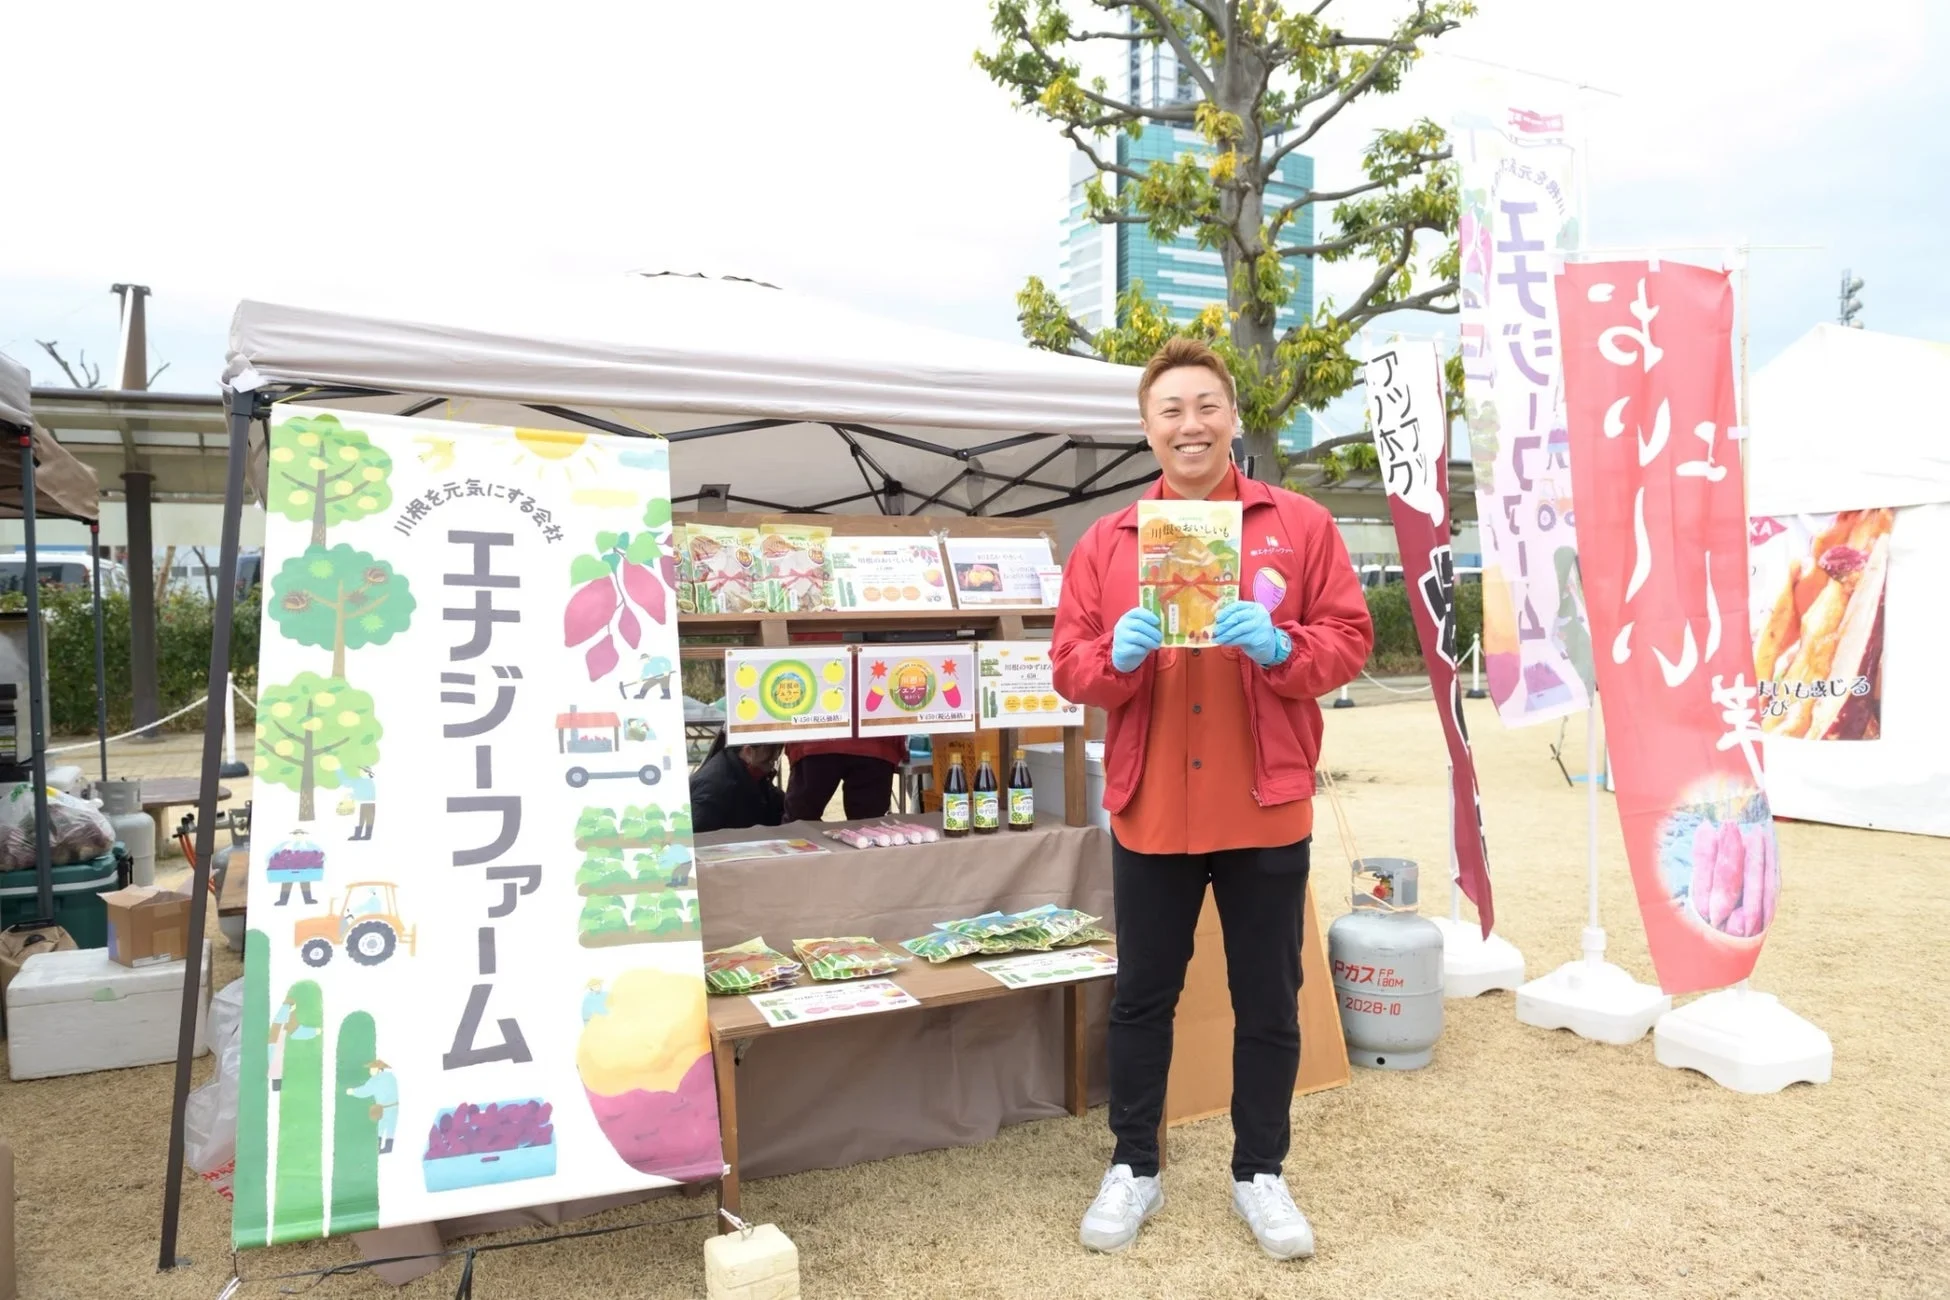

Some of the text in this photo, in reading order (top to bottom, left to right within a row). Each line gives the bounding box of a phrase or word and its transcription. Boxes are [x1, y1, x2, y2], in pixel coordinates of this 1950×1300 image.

[394, 478, 564, 545] 川根を元気にする会社
[441, 529, 543, 1071] エナジーファーム
[1345, 996, 1403, 1017] 2028-10
